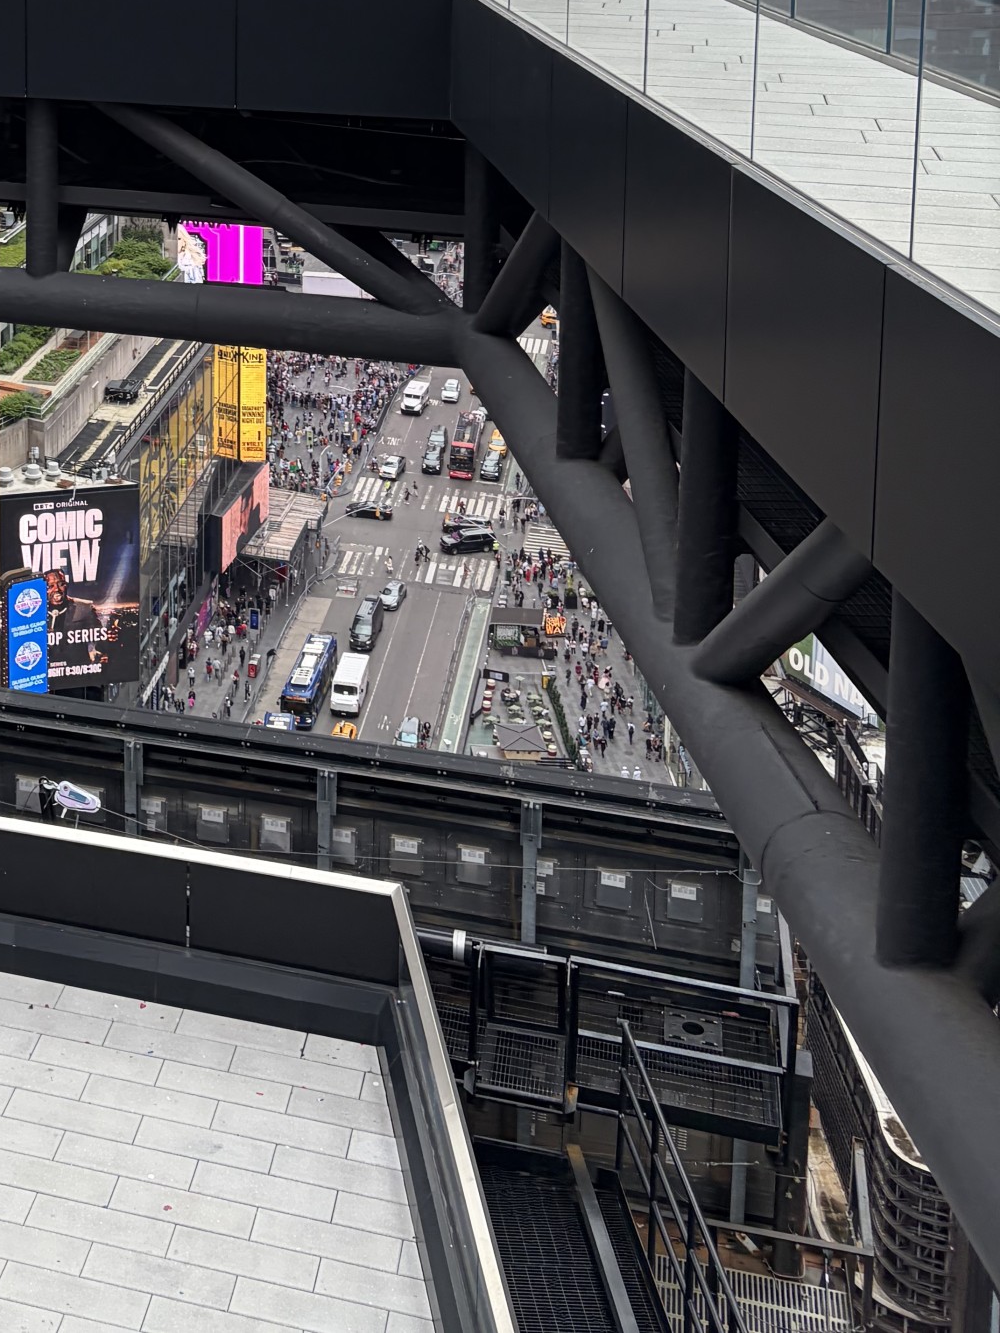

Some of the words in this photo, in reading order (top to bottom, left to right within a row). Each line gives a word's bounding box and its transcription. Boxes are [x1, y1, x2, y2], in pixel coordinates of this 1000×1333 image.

[56, 500, 89, 508] ORIGINAL
[19, 508, 104, 544] COMIC
[21, 538, 101, 583] VIEW
[67, 627, 108, 644] SERIES
[789, 647, 829, 687] OLD
[834, 672, 864, 706] NA
